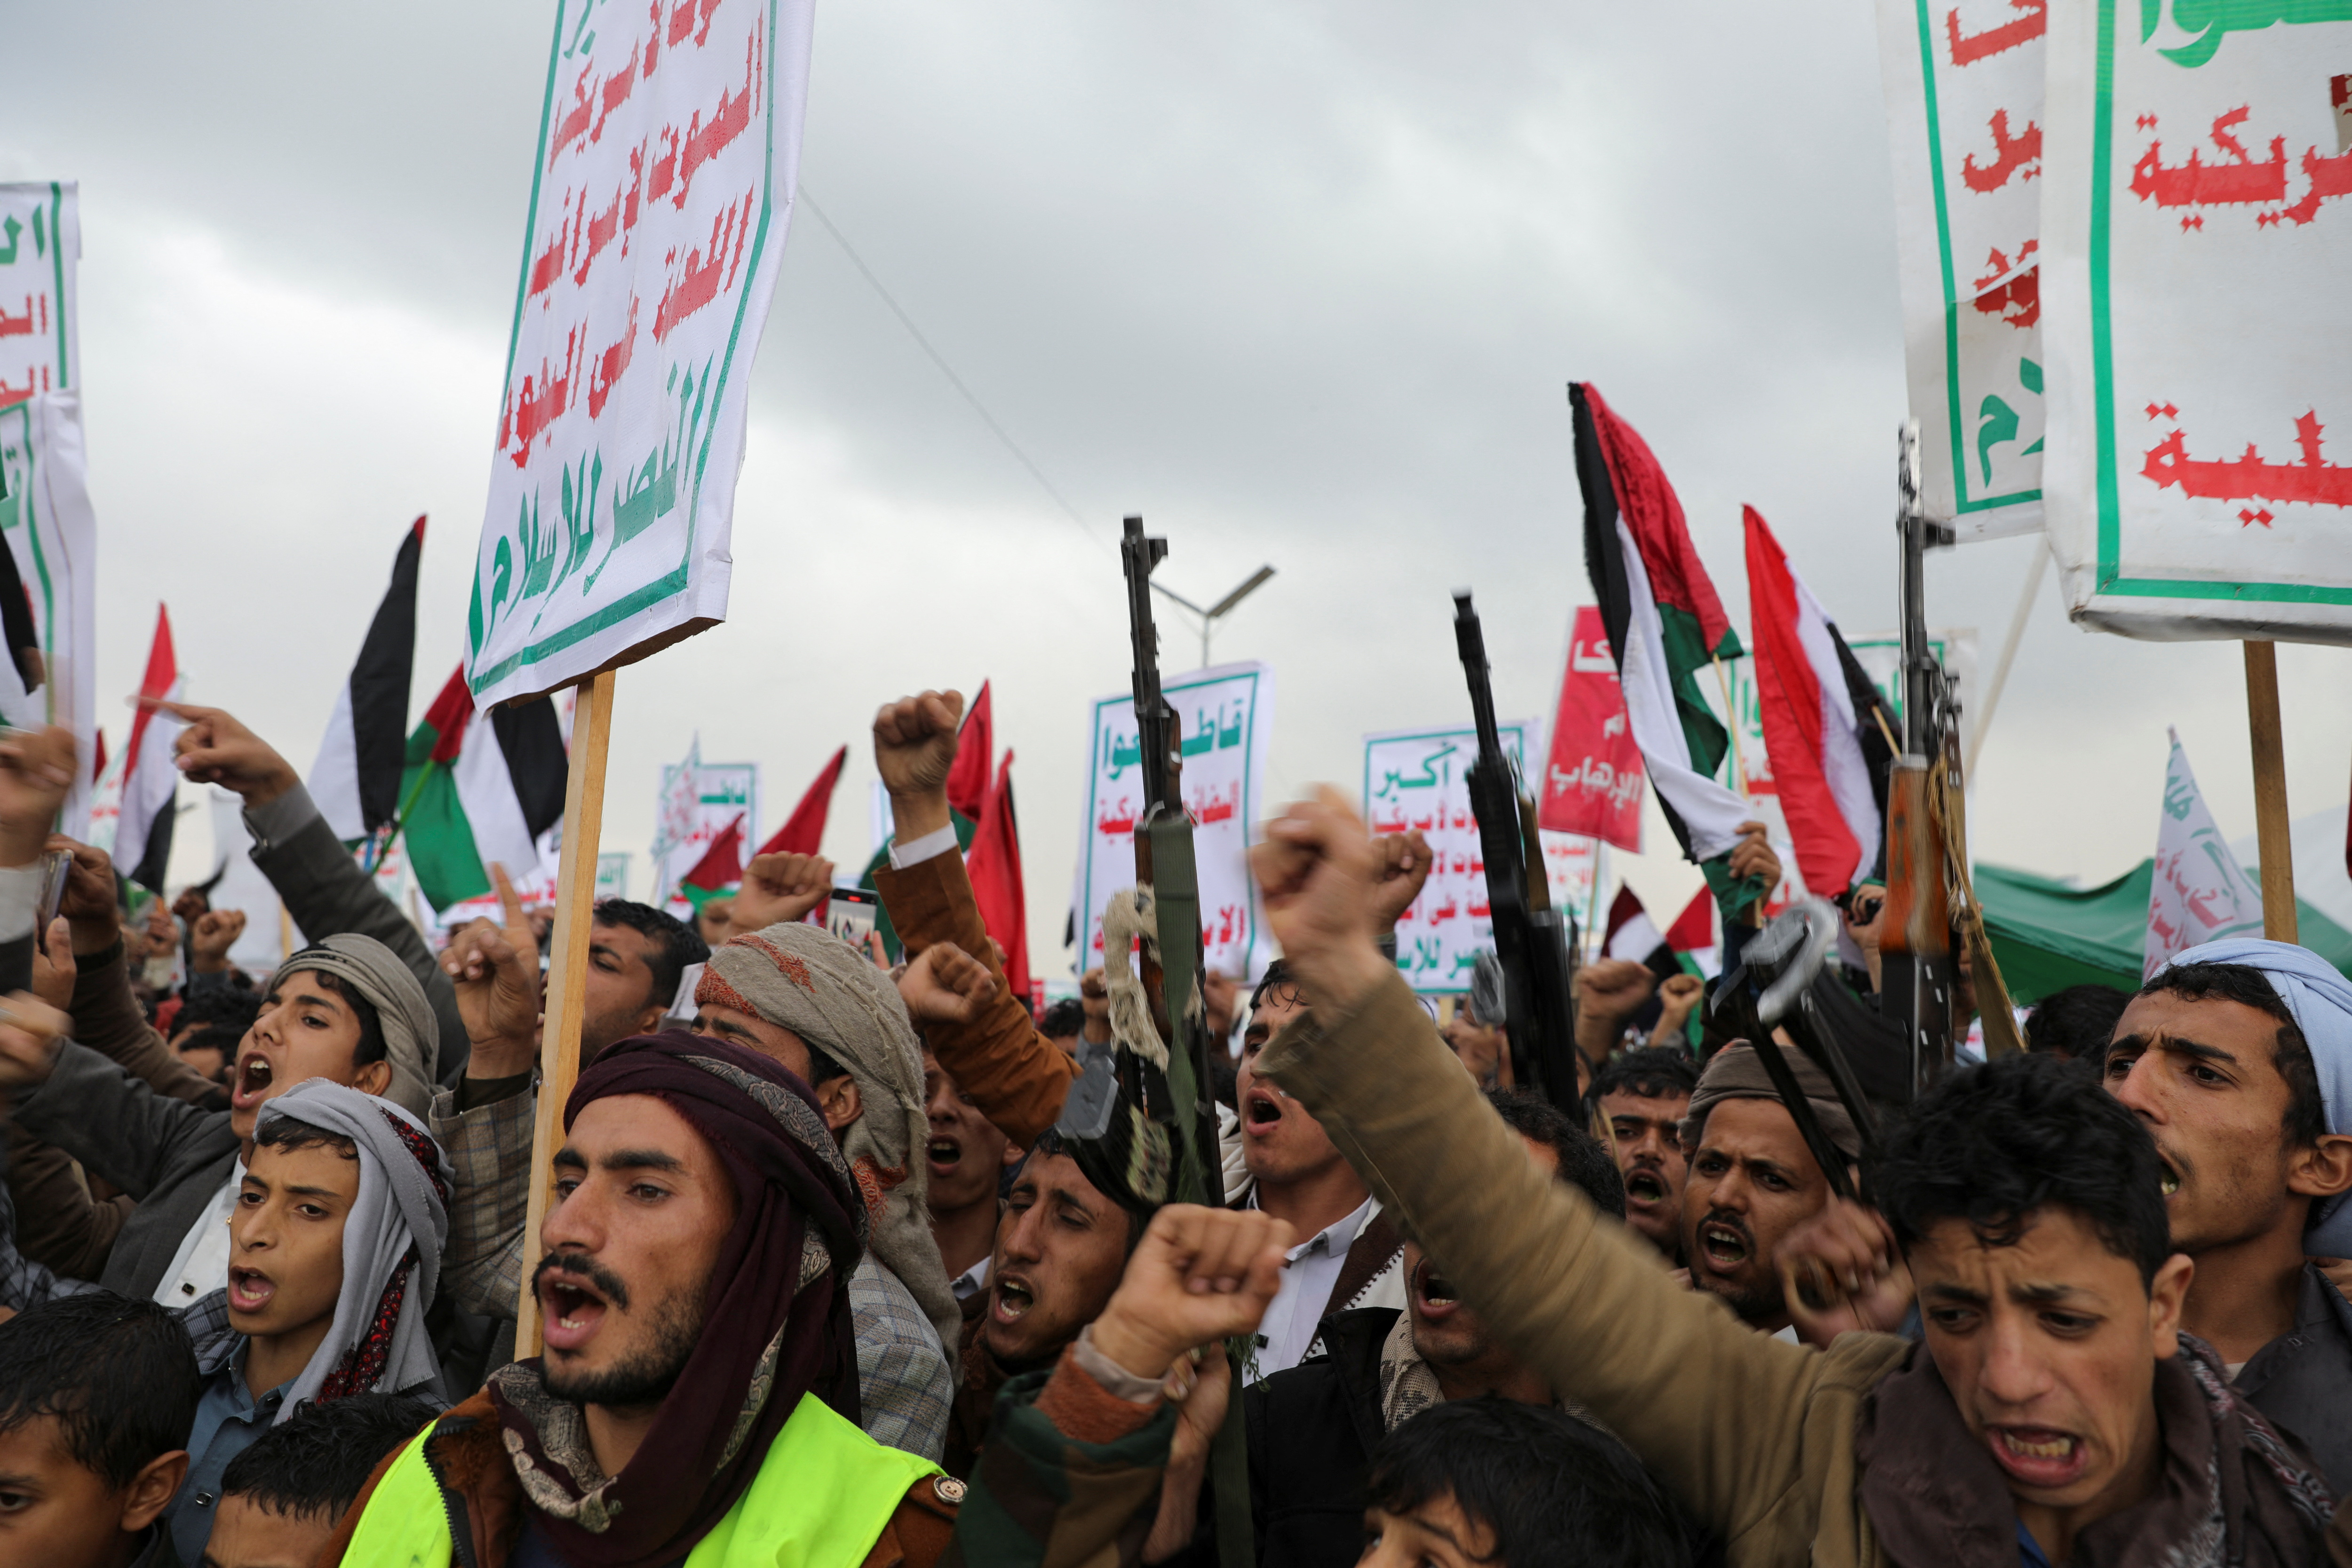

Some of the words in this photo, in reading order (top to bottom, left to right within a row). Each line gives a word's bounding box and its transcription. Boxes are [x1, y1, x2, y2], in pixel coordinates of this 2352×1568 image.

[647, 3, 763, 213] الموت
[523, 132, 648, 318] لإسرائيل
[652, 178, 755, 348] اللعنة
[498, 310, 589, 470] اليهود
[583, 348, 715, 597] النصر
[484, 440, 603, 653] للإسلام
[1374, 741, 1457, 803] أكبر
